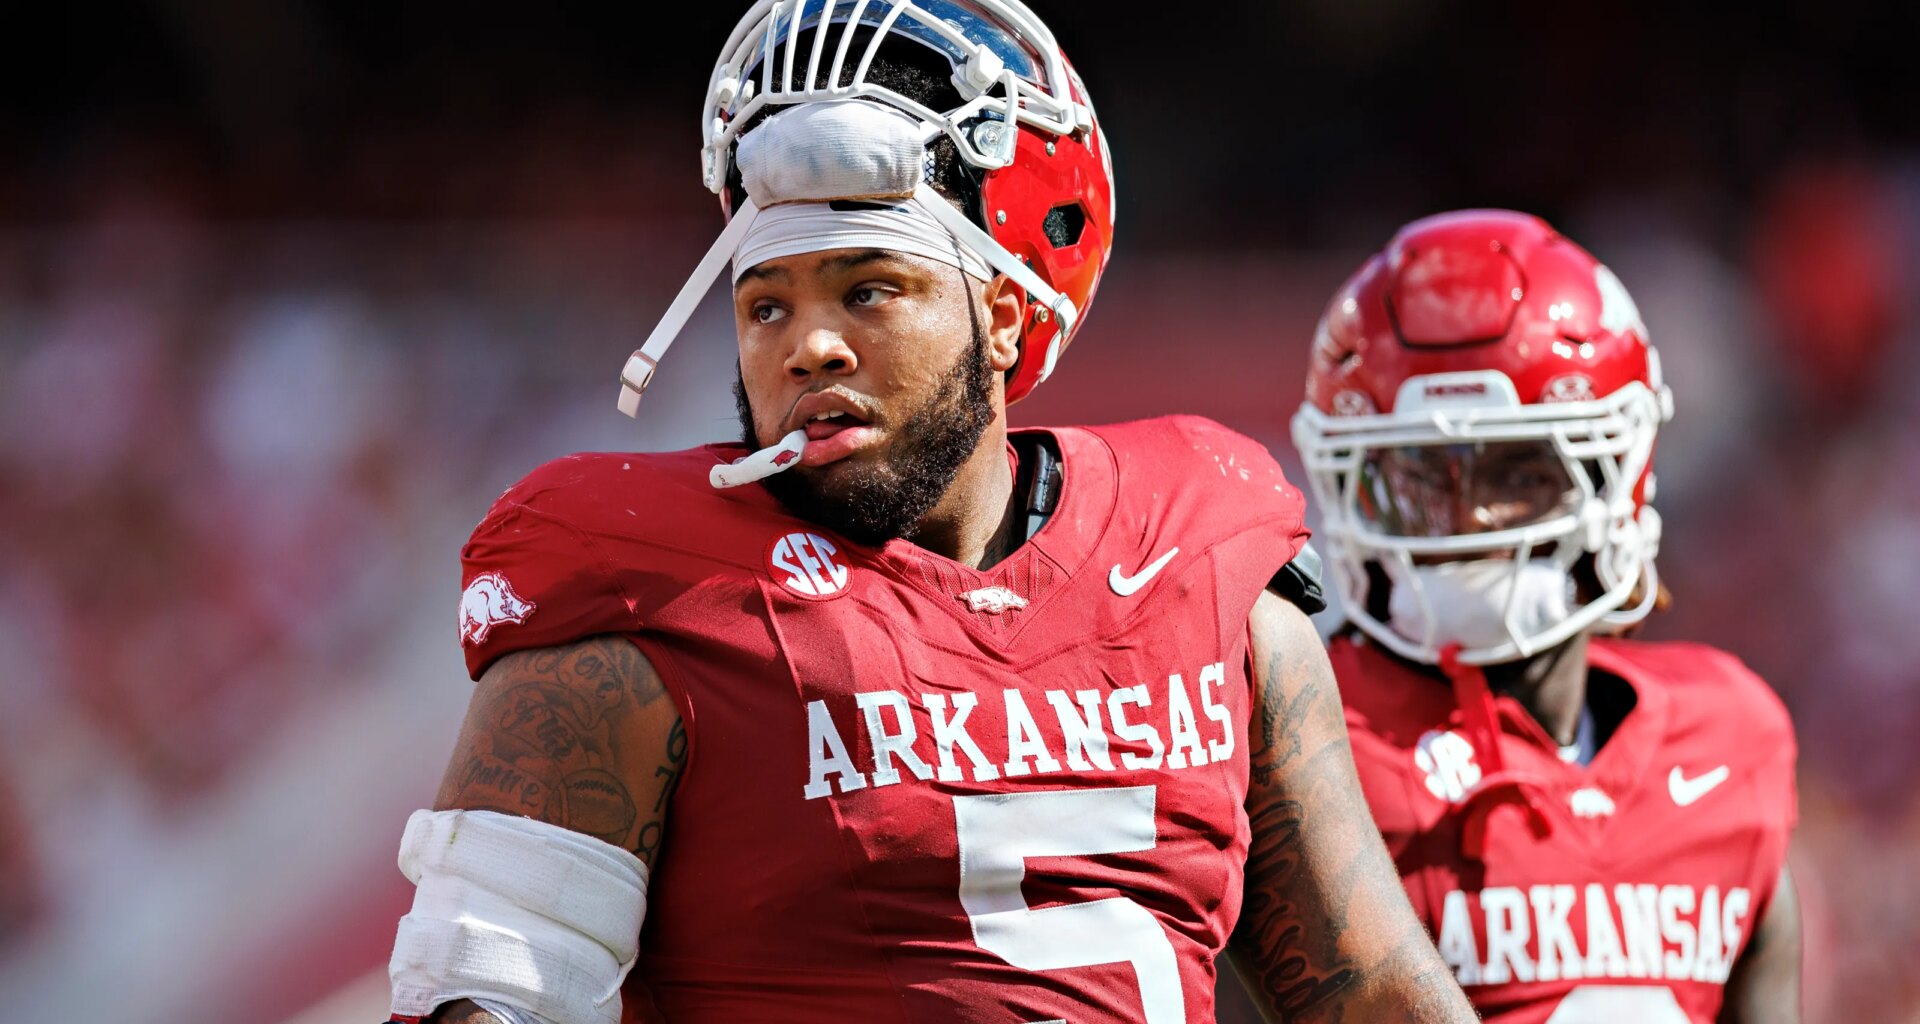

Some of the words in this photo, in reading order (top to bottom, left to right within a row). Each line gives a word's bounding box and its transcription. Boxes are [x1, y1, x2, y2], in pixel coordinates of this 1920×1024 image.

[772, 532, 849, 596] SEC
[804, 662, 1235, 800] ARKANSAS
[952, 785, 1187, 1024] 5
[1438, 882, 1751, 985] ARKANSAS
